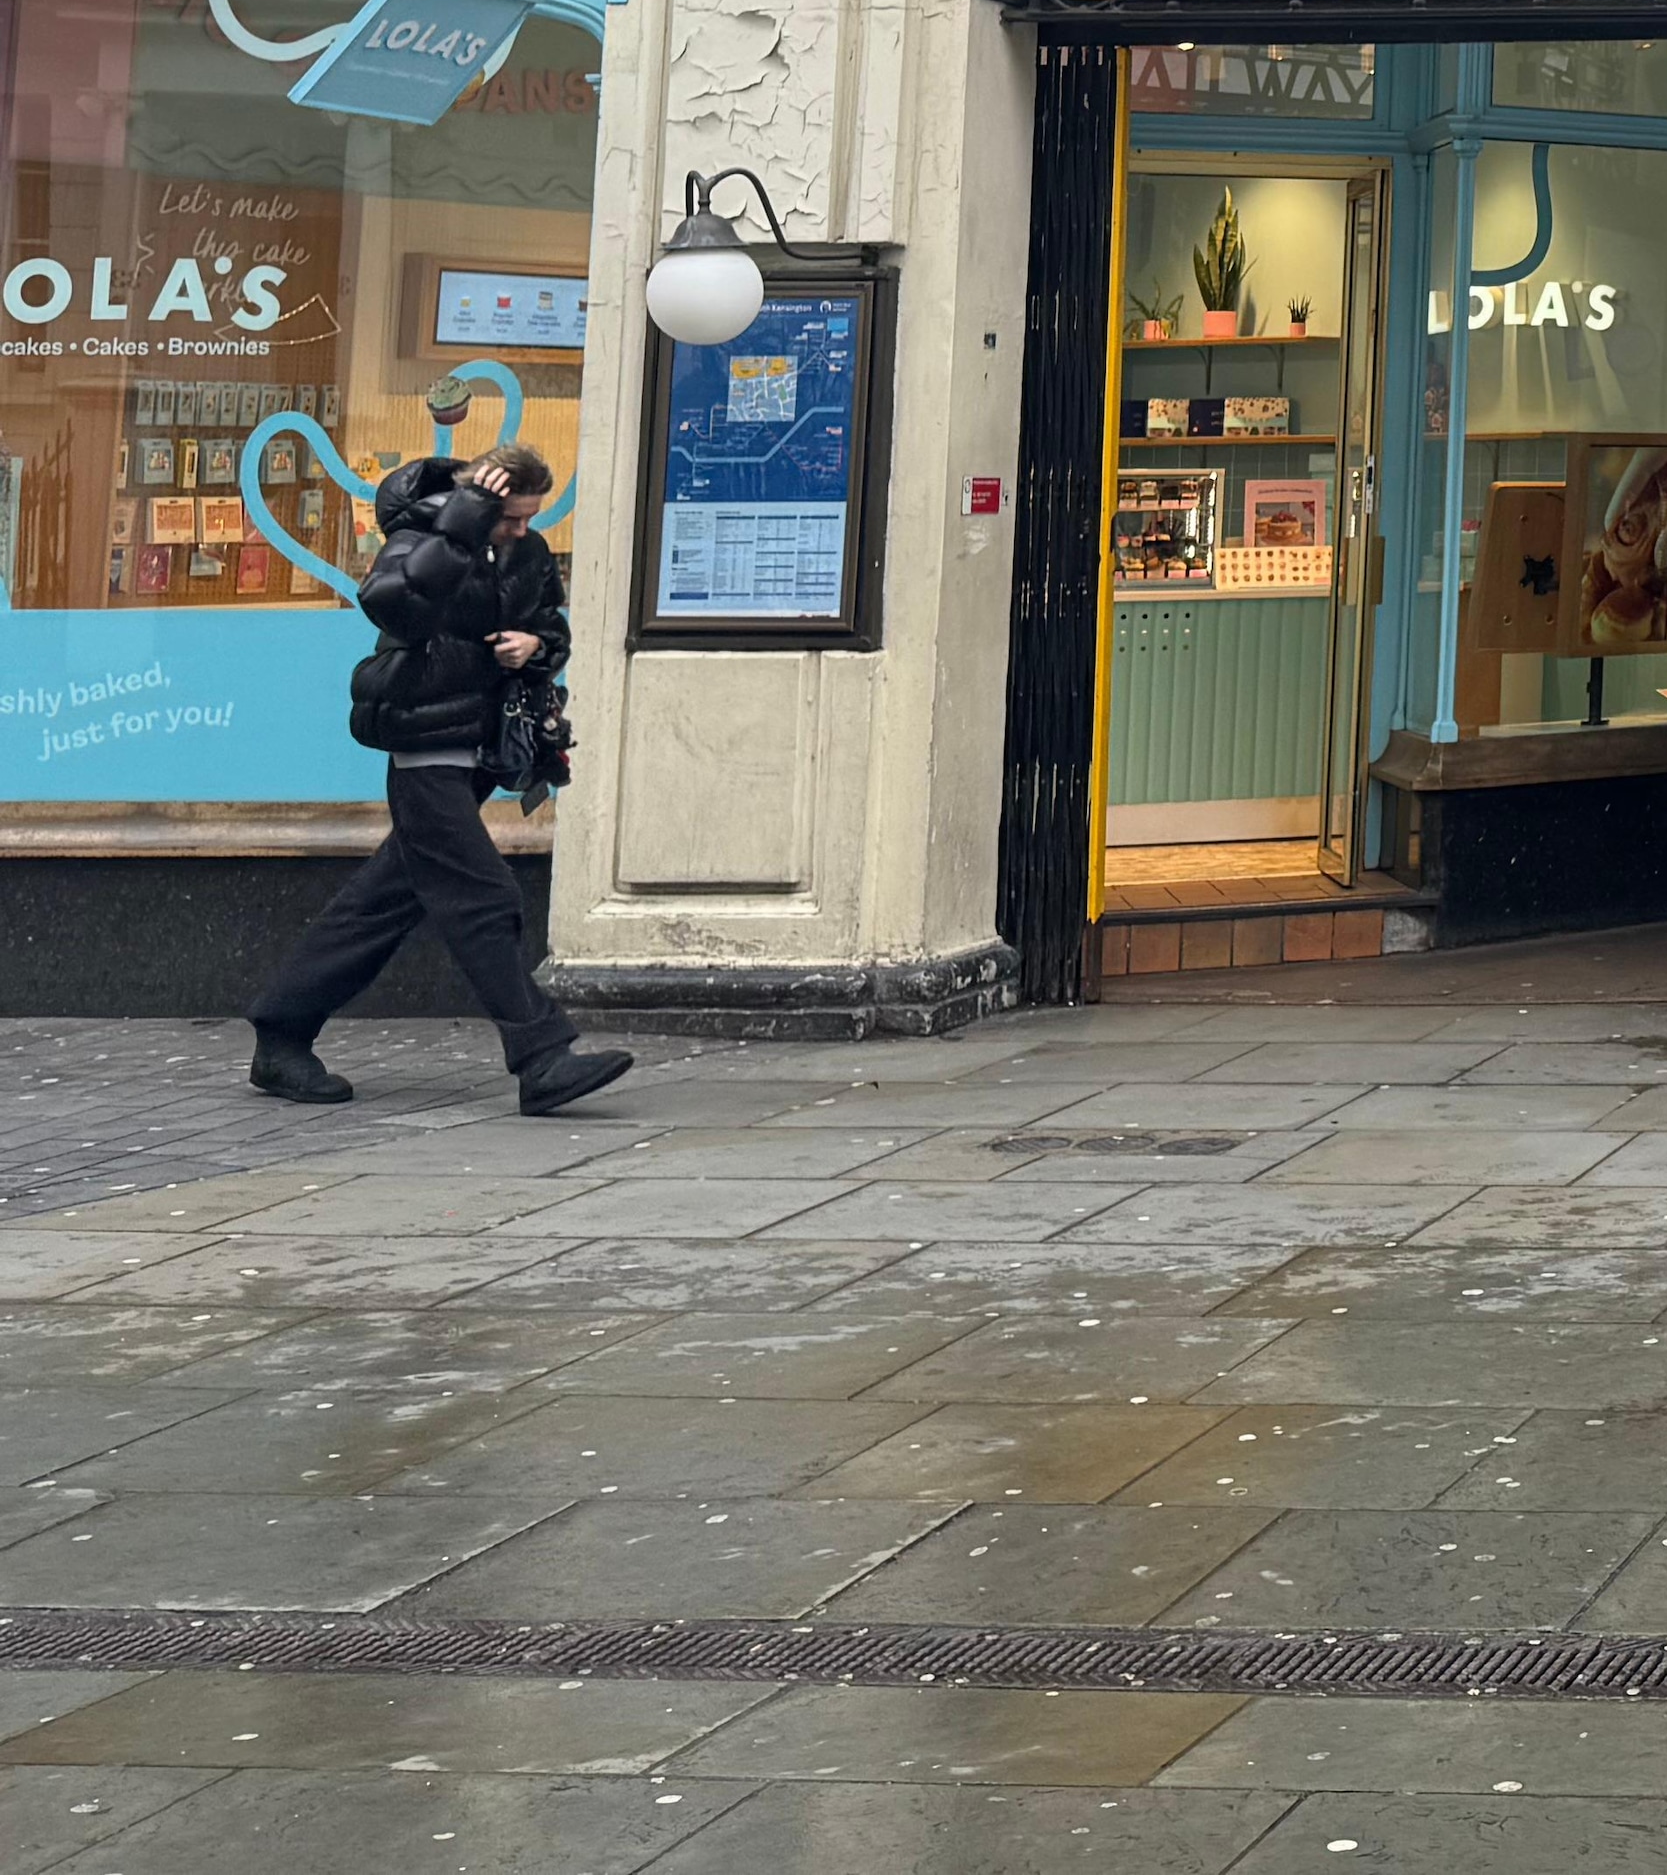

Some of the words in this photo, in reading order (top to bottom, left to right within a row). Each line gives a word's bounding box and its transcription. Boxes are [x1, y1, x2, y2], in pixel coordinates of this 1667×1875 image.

[365, 19, 487, 66] LOLA'S
[160, 183, 223, 216] Let's
[230, 195, 299, 221] make
[192, 227, 244, 256] this
[252, 239, 311, 265] cake
[3, 256, 287, 331] OLA'S
[1427, 281, 1616, 335] LOLA'S
[1, 337, 63, 356] cakes
[83, 337, 149, 356] Cakes
[168, 336, 270, 356] Brownies
[69, 661, 171, 707] baked,
[37, 722, 104, 761] just
[111, 710, 159, 737] for
[165, 701, 234, 733] you!
